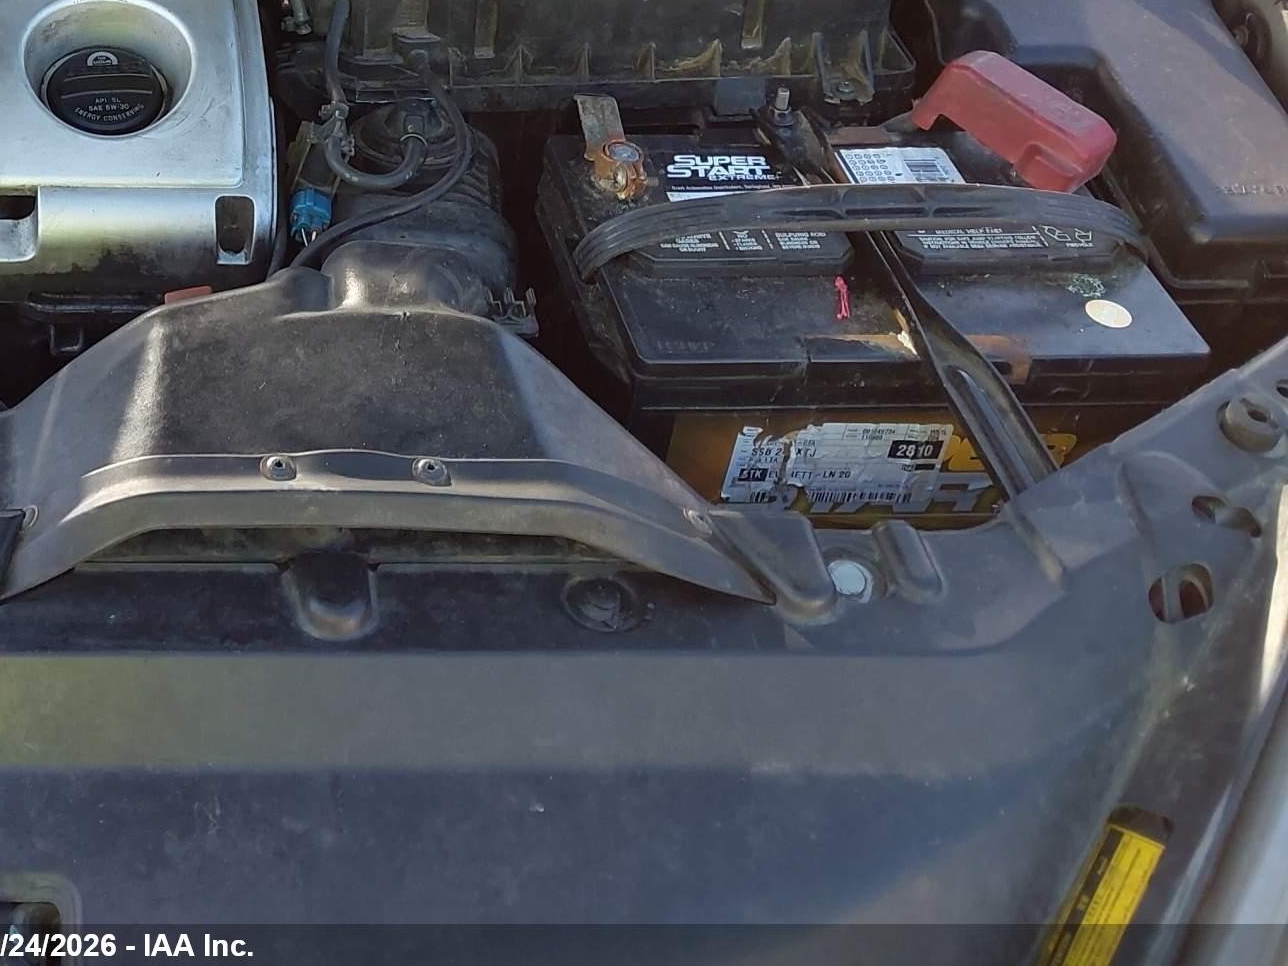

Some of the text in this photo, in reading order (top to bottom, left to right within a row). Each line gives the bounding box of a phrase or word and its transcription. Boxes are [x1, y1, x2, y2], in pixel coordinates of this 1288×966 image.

[95, 96, 108, 104] API
[673, 154, 767, 167] SUPER
[666, 164, 771, 178] START
